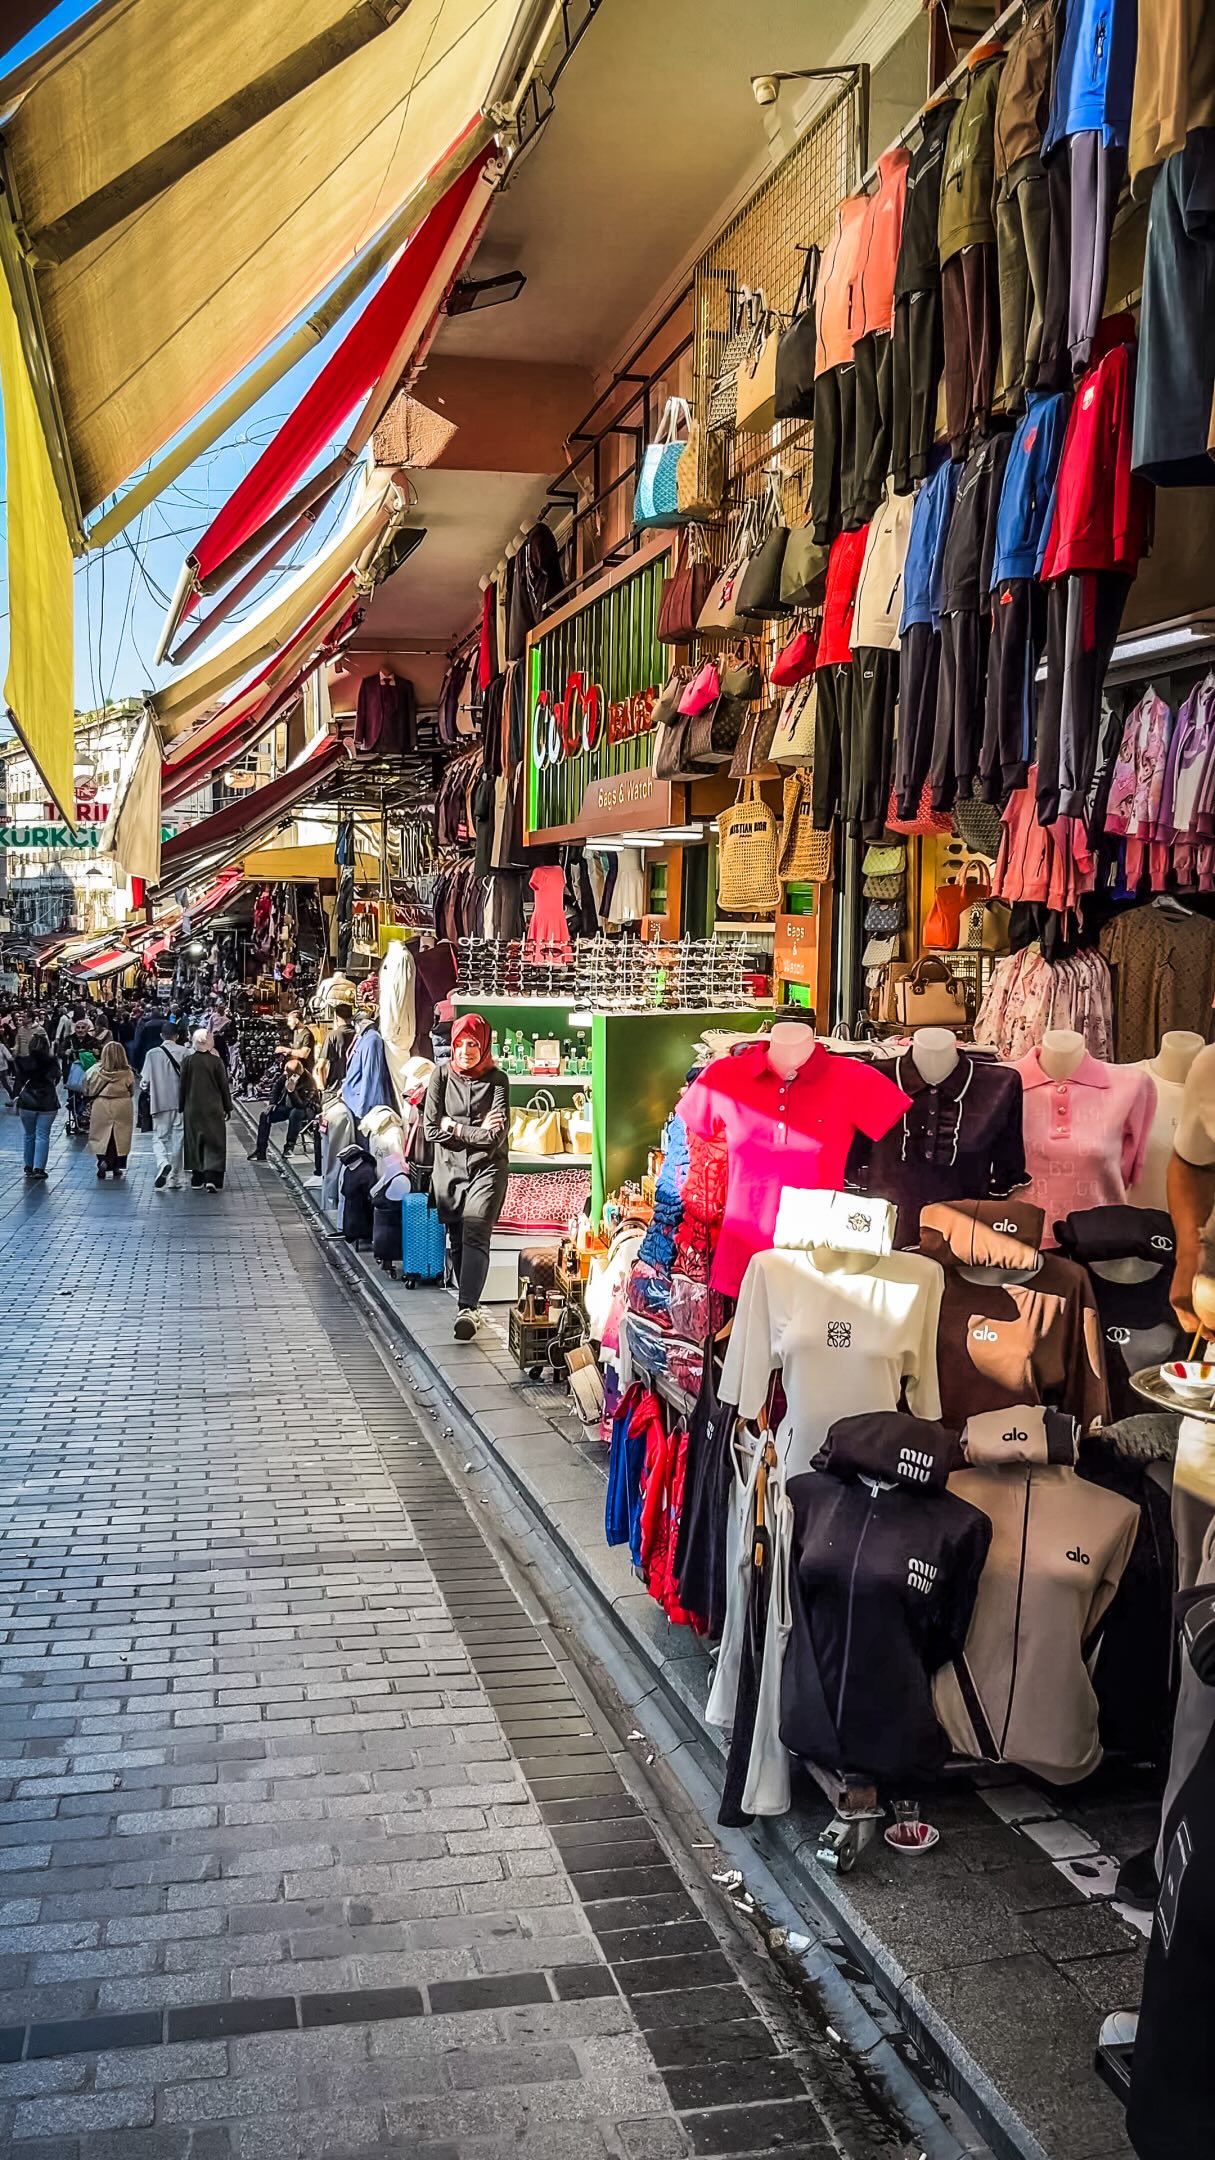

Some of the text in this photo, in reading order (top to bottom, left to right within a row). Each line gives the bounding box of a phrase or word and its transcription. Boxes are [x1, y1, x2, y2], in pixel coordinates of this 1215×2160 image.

[598, 775, 653, 811] Bags & Watch
[992, 1218, 1018, 1234] alo
[972, 1325, 999, 1342] alo
[1002, 1427, 1029, 1442] alo
[1065, 1546, 1091, 1566] alo
